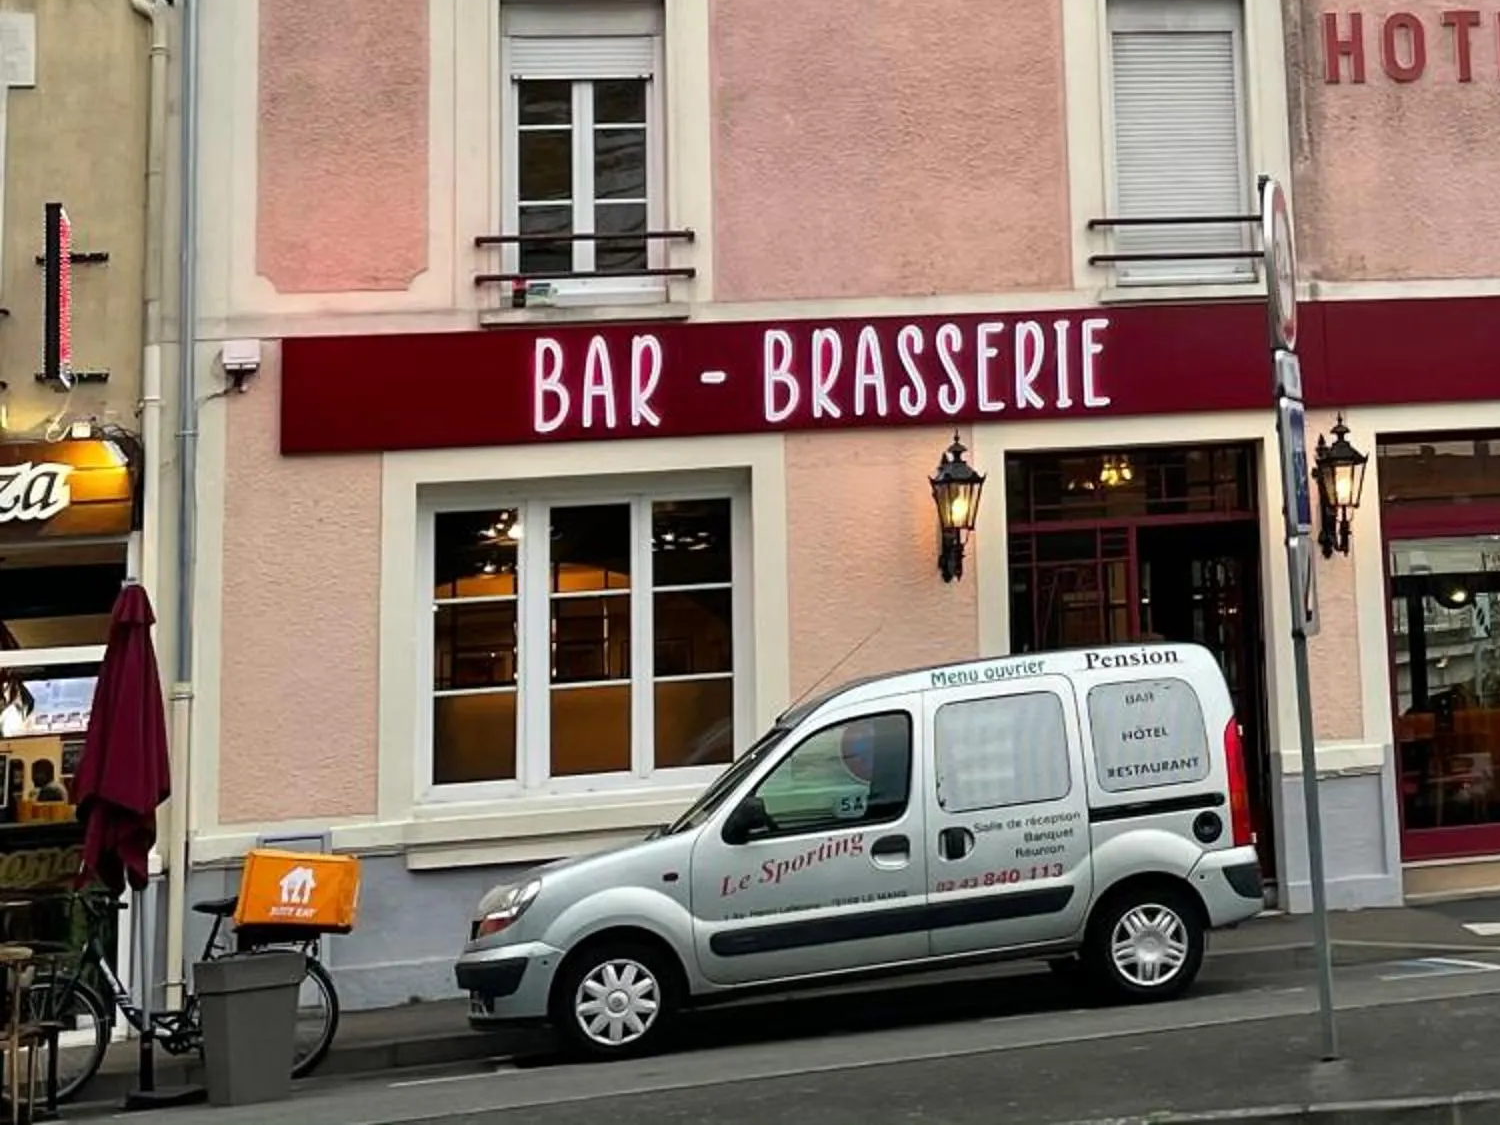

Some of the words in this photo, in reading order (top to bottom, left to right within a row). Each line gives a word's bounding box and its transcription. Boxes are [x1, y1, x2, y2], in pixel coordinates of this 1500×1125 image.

[533, 334, 663, 433] BAR
[764, 318, 1111, 423] BRASSERIE
[1084, 648, 1179, 671] Pension
[930, 668, 979, 688] Menu
[983, 659, 1046, 681] ouvrier
[1124, 691, 1154, 705] BAR
[1107, 756, 1199, 779] RESTAURANT
[1006, 818, 1022, 829] de
[1023, 827, 1073, 843] Banquet
[1015, 844, 1065, 859] Réunion
[719, 874, 752, 898] Le
[758, 832, 865, 884] Sporting
[936, 880, 955, 893] 02
[983, 868, 1021, 886] 840
